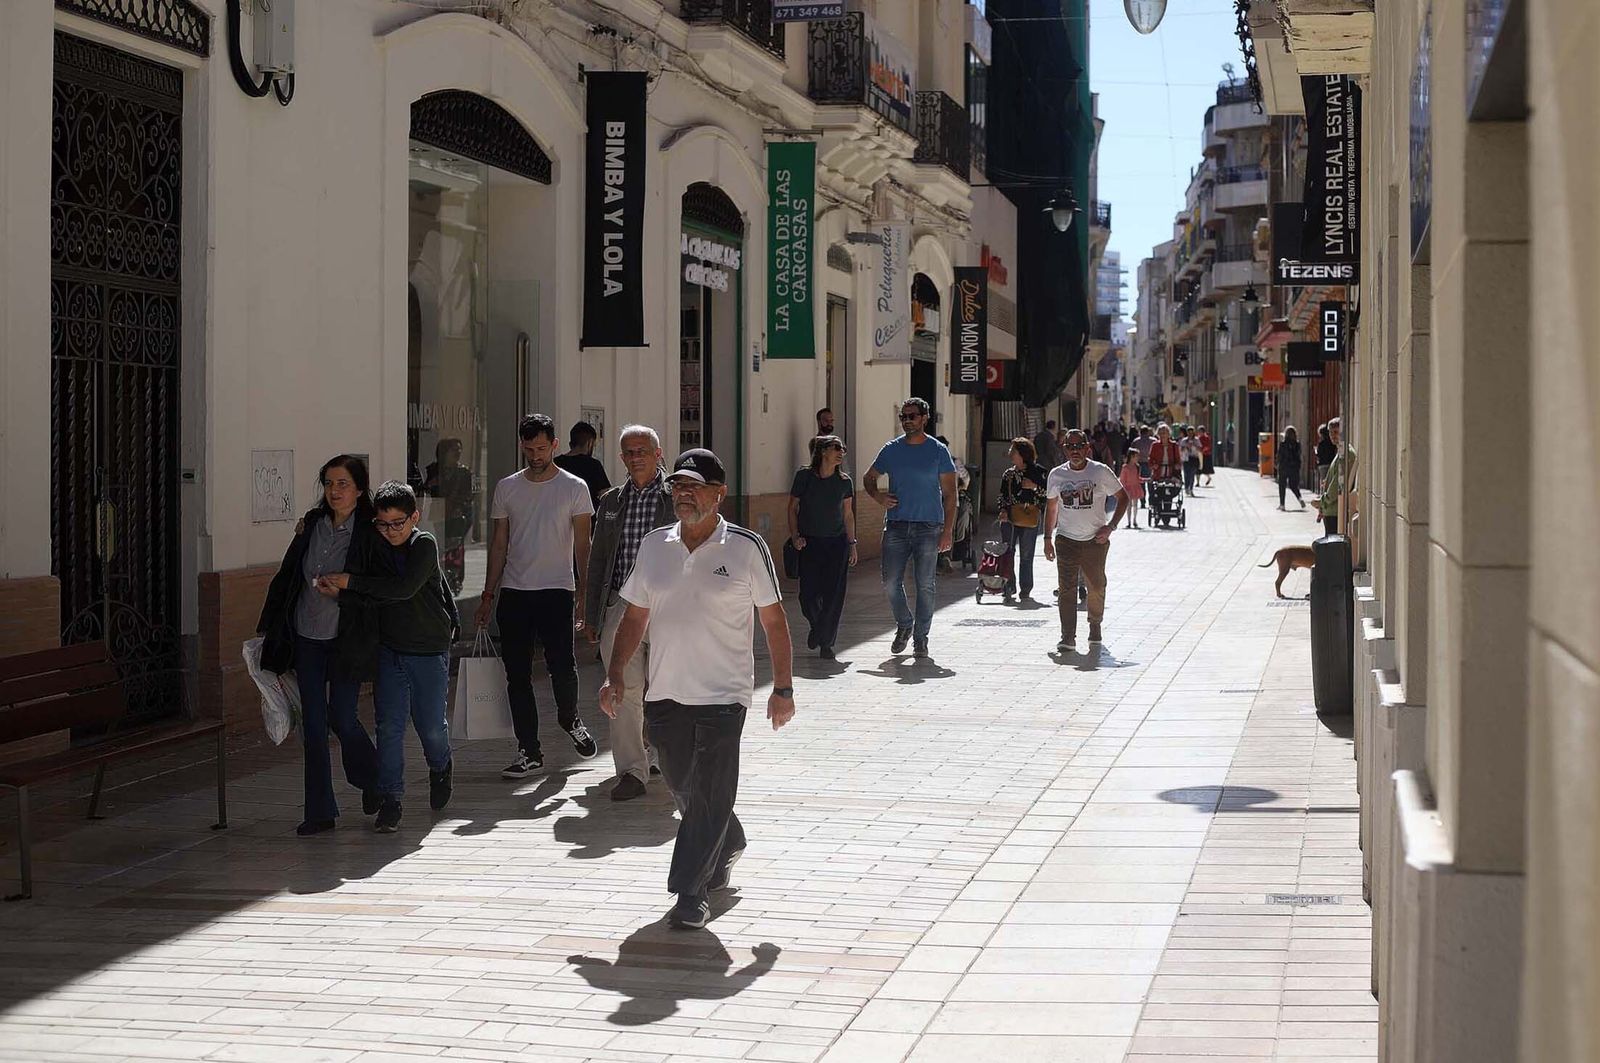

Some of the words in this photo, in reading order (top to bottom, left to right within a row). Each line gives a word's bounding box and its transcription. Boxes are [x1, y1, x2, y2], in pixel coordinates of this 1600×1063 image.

[775, 8, 795, 18] 671
[798, 7, 819, 17] 349
[821, 6, 842, 16] 468
[1325, 73, 1344, 138] ESTATE
[604, 121, 626, 204] BIMBA
[1325, 141, 1344, 190] REAL
[1347, 139, 1356, 172] REFORMA
[775, 169, 791, 207] LAS
[1347, 180, 1356, 201] VENTA
[604, 208, 624, 227] Y
[775, 214, 790, 241] DE
[1325, 195, 1344, 255] LYNCIS
[603, 232, 624, 297] LOLA
[775, 244, 791, 297] CASA
[792, 198, 808, 303] CARCASAS
[1278, 264, 1354, 279] TEZENIS
[775, 303, 790, 332] LA
[959, 279, 982, 323] Dulce
[960, 323, 979, 383] MOMENTO
